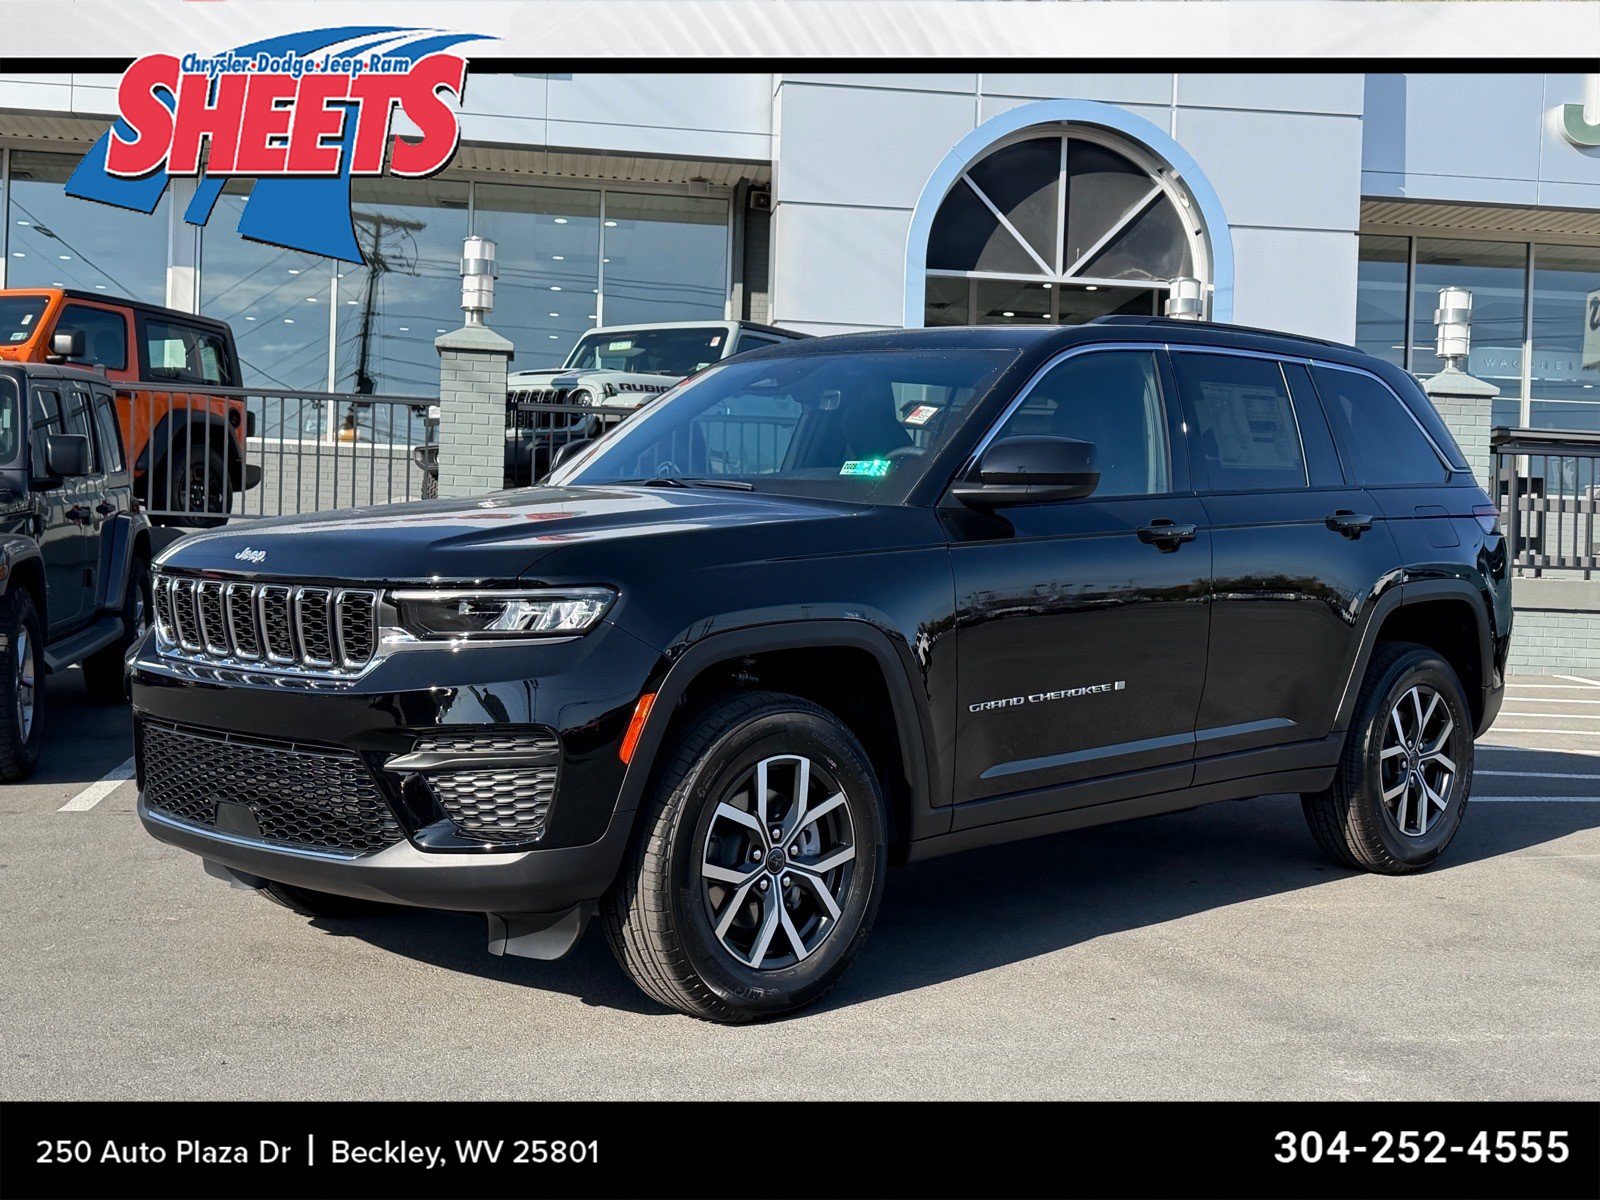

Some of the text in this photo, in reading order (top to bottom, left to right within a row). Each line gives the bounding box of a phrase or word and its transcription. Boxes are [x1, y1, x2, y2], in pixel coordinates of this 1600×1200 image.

[618, 383, 670, 394] RUBIC
[234, 546, 267, 564] Jeep
[968, 683, 1112, 713] GRAND CHEROKEE
